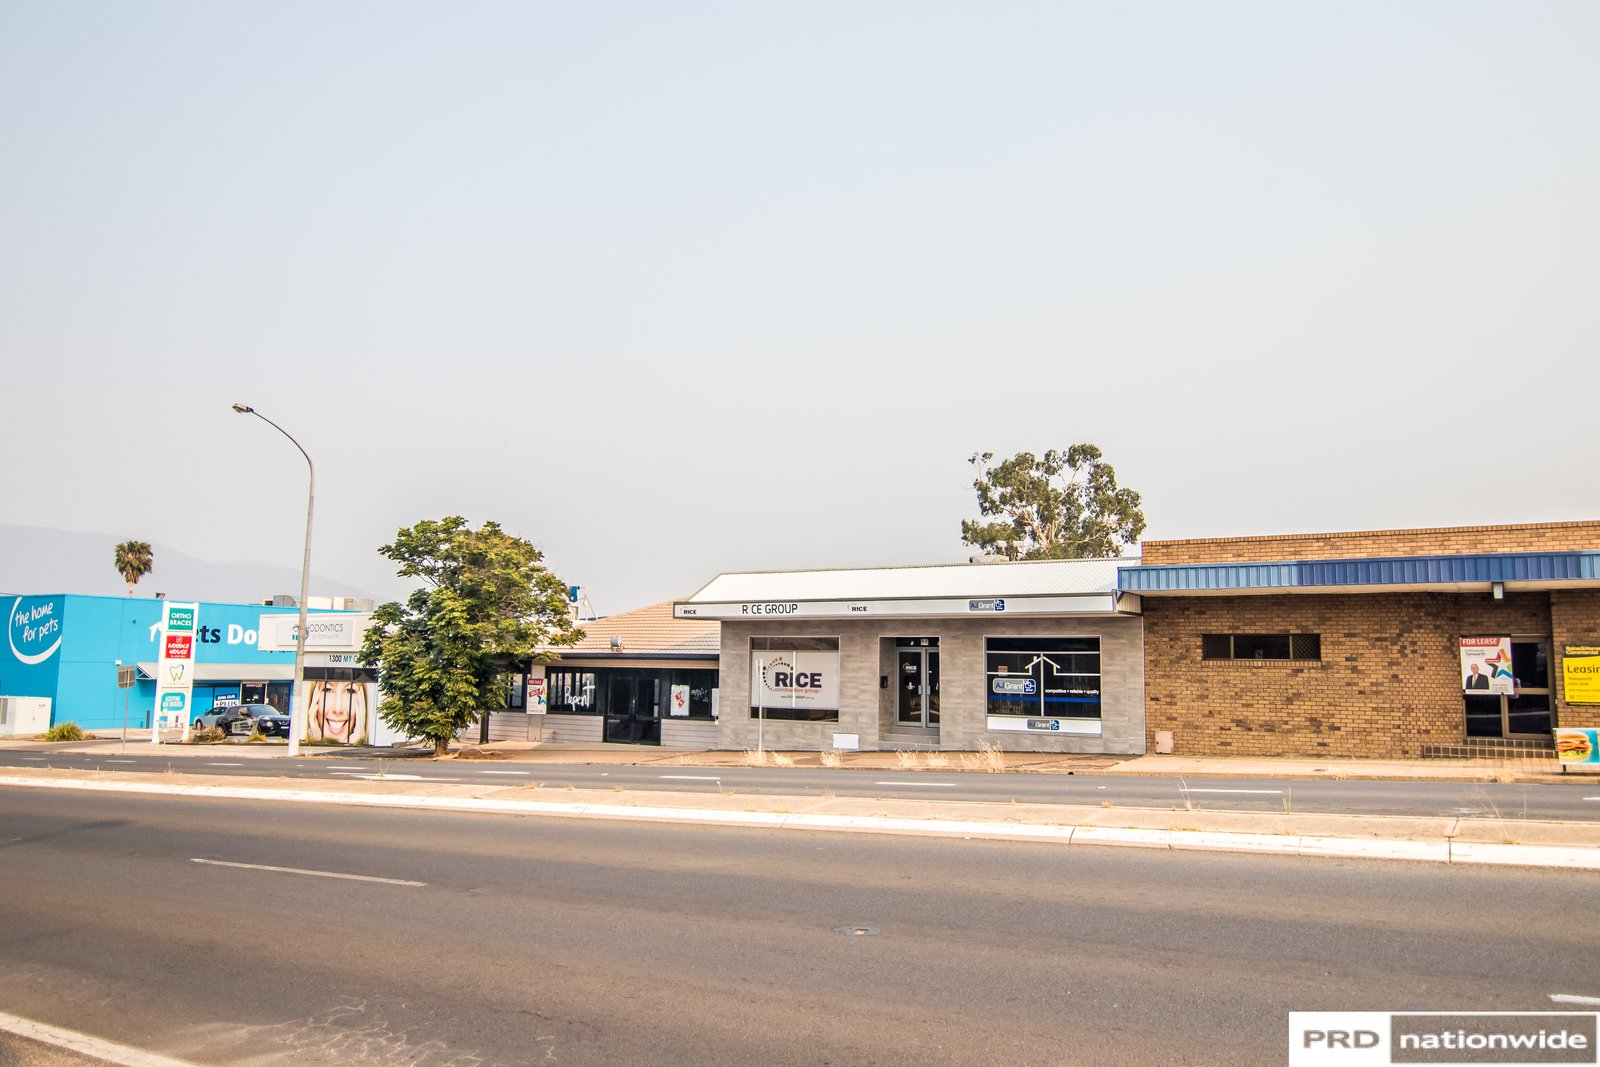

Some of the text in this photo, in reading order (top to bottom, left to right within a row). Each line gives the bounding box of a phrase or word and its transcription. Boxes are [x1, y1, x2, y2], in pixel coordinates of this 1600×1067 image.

[15, 602, 54, 627] the home
[742, 603, 798, 615] RCE GROUP
[23, 618, 59, 643] for pets
[227, 624, 260, 646] Do
[329, 654, 342, 663] 1300
[343, 654, 353, 663] MY
